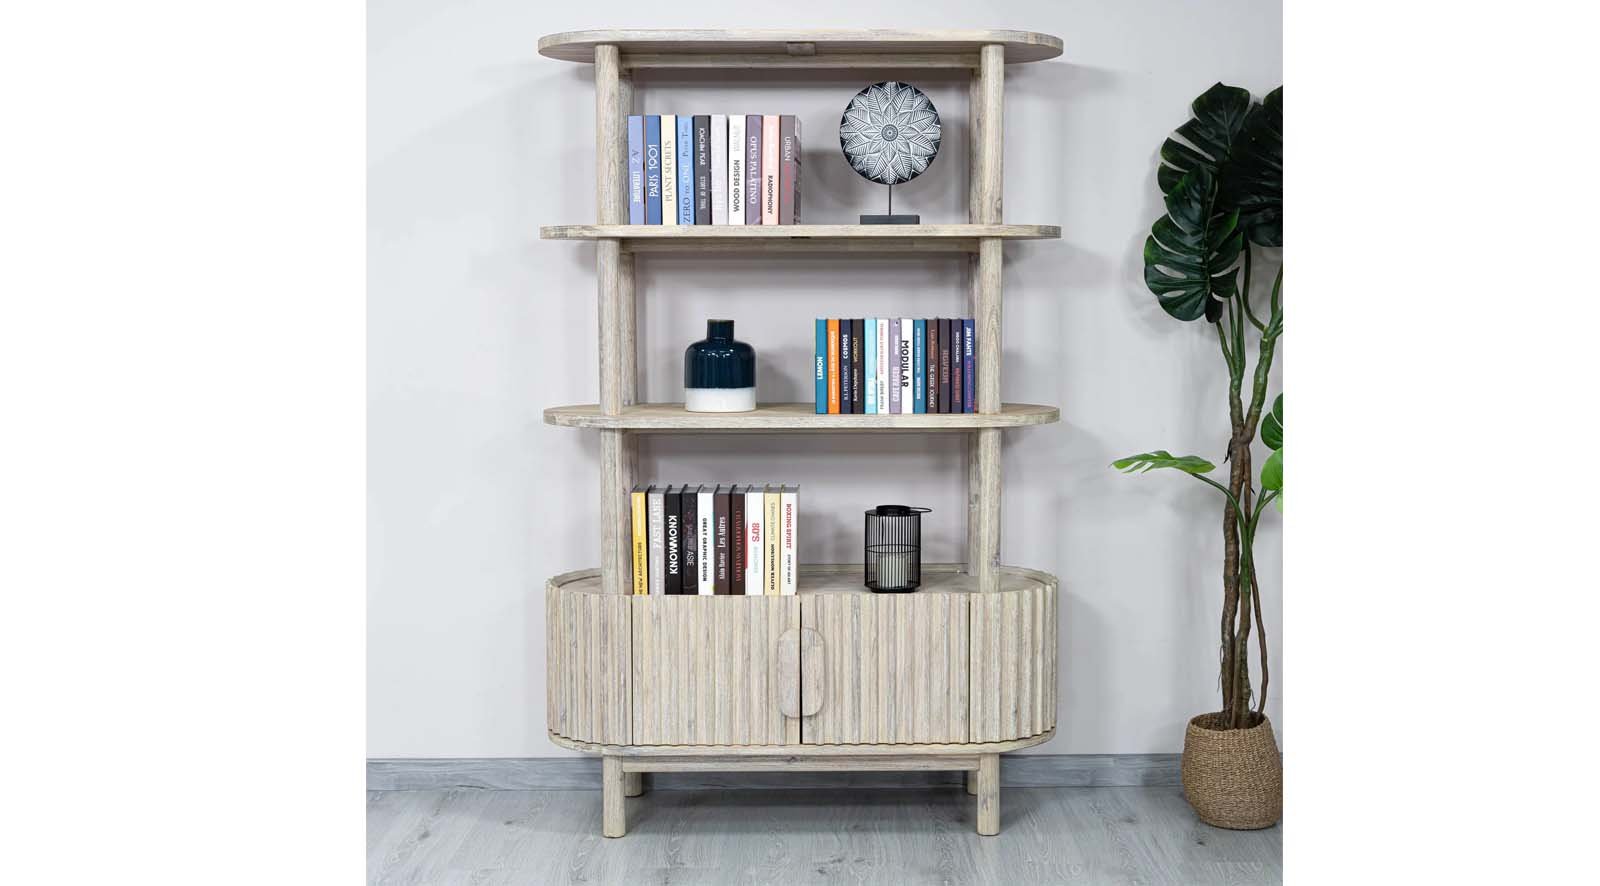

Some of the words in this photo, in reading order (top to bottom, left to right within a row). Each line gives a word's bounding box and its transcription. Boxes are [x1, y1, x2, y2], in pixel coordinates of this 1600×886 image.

[647, 144, 658, 170] 1901
[663, 140, 672, 174] SECRETS
[784, 136, 792, 161] URBAN
[648, 174, 659, 198] PARIS
[664, 176, 673, 202] PLANT
[682, 197, 691, 223] ZERO
[816, 356, 824, 380] LEMON
[901, 340, 910, 388] MODULAR
[718, 516, 726, 536] Autres
[717, 537, 726, 548] Les
[686, 550, 695, 566] ASIE
